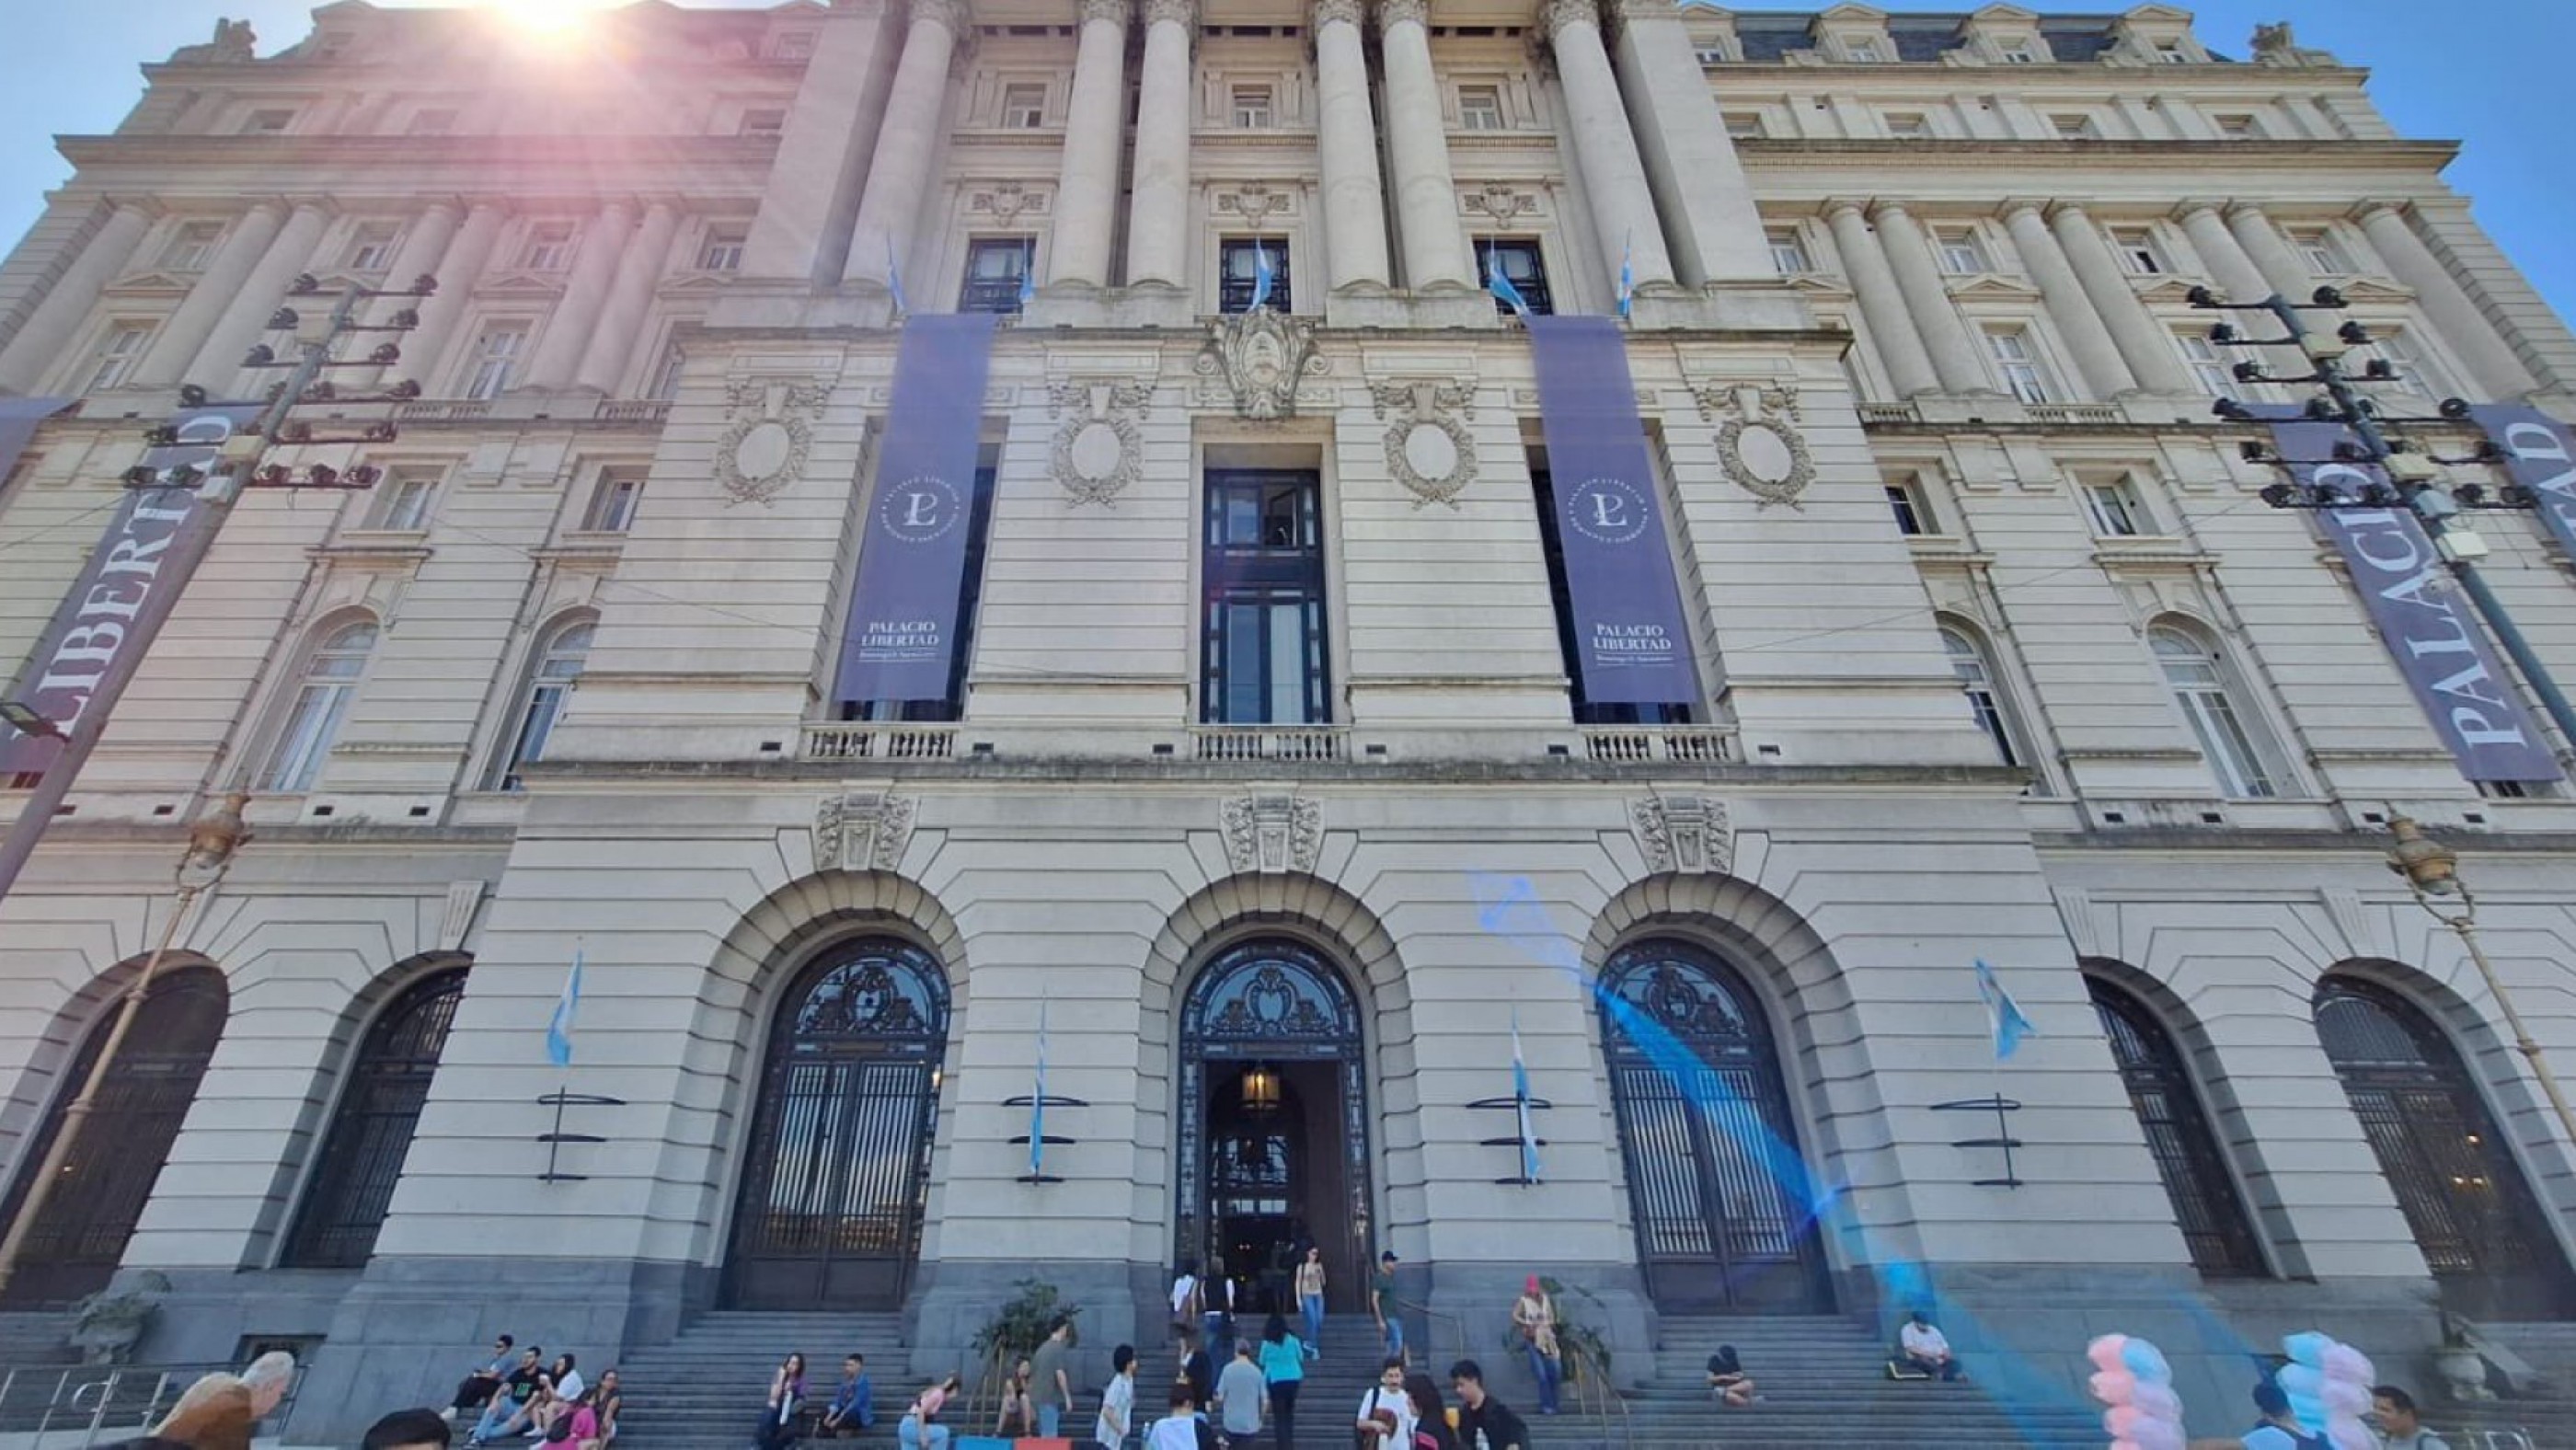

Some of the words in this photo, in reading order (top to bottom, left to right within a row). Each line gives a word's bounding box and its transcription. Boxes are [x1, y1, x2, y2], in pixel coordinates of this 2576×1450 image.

[868, 622, 936, 634] PALACIO
[1597, 624, 1664, 637] PALACIO
[861, 635, 938, 646] LIBERTAD
[1592, 637, 1672, 650] LIBERTAD
